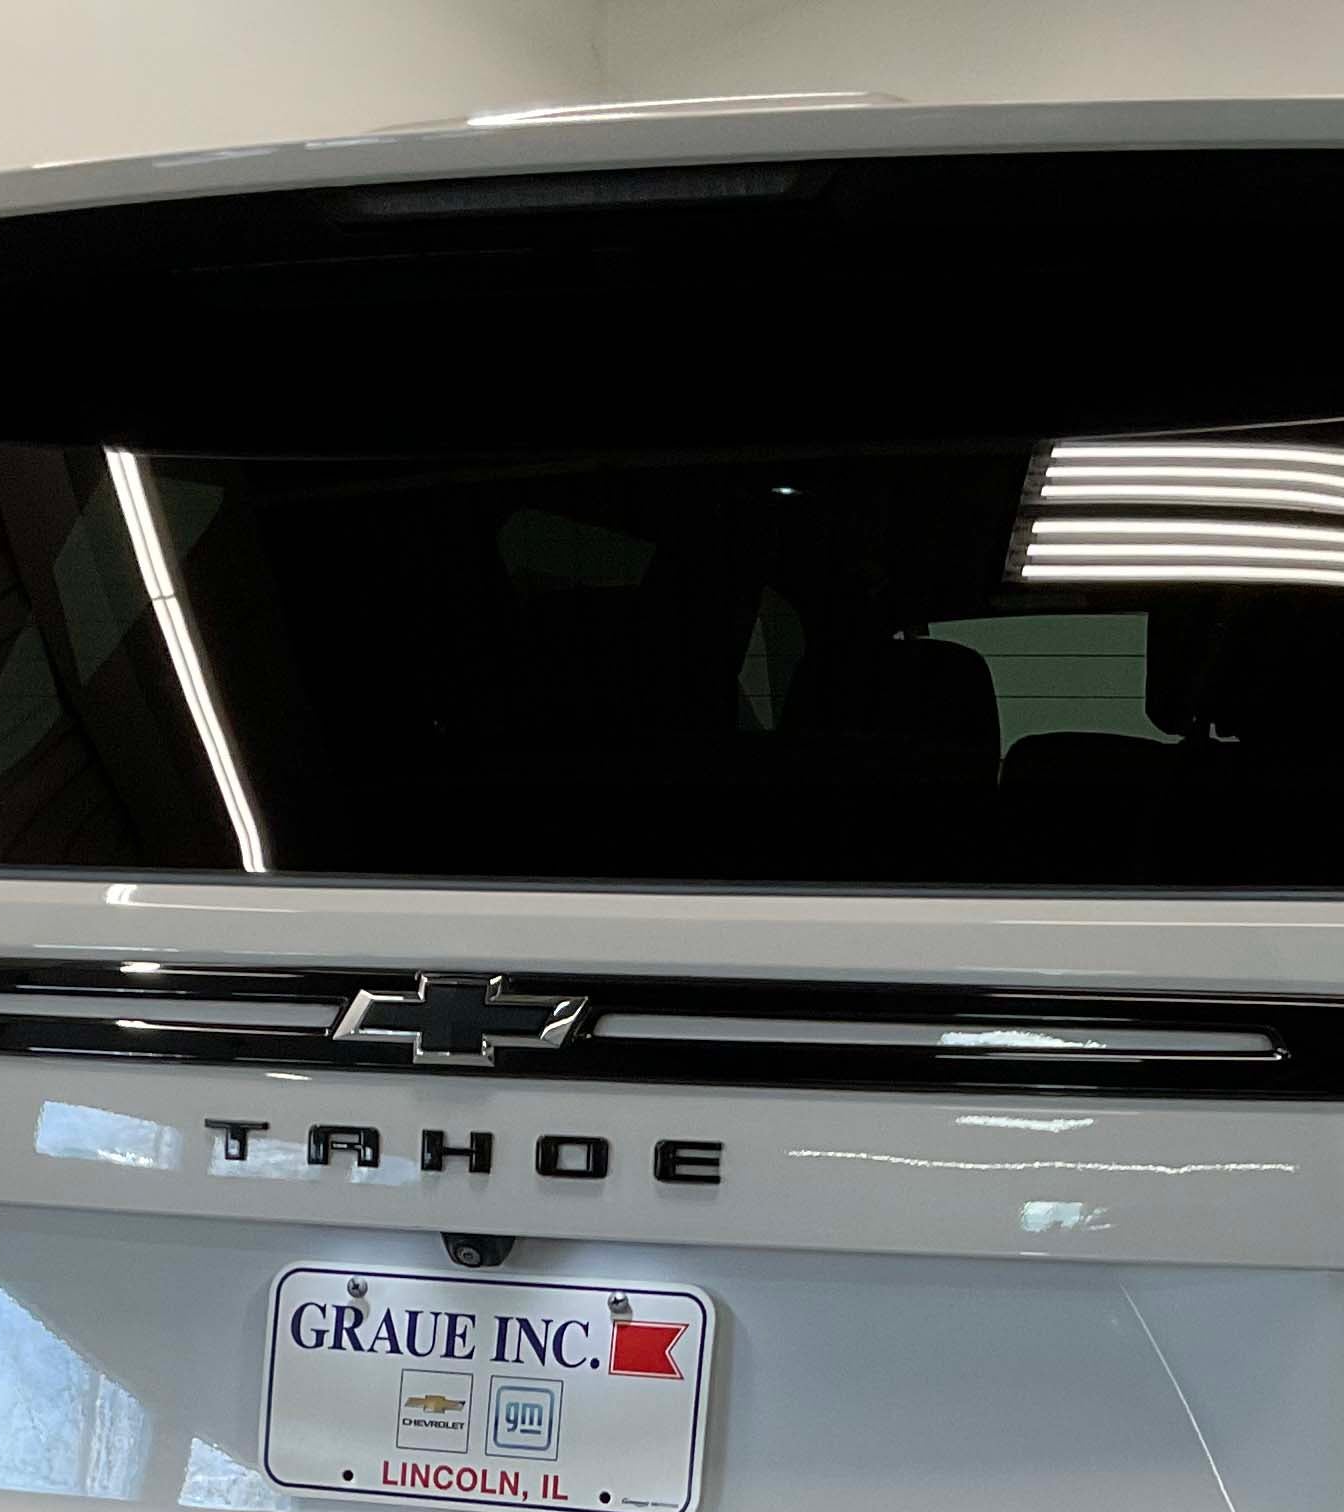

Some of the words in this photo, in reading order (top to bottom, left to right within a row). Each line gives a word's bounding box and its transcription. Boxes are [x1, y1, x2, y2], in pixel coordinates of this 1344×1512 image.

[203, 1118, 725, 1185] TAHOE
[289, 1300, 478, 1361] GRAUE
[489, 1314, 601, 1371] INC.
[401, 1416, 466, 1431] CHEVROLET
[505, 1399, 544, 1435] gm
[380, 1460, 529, 1502] LINCOLN,
[541, 1473, 569, 1501] IL
